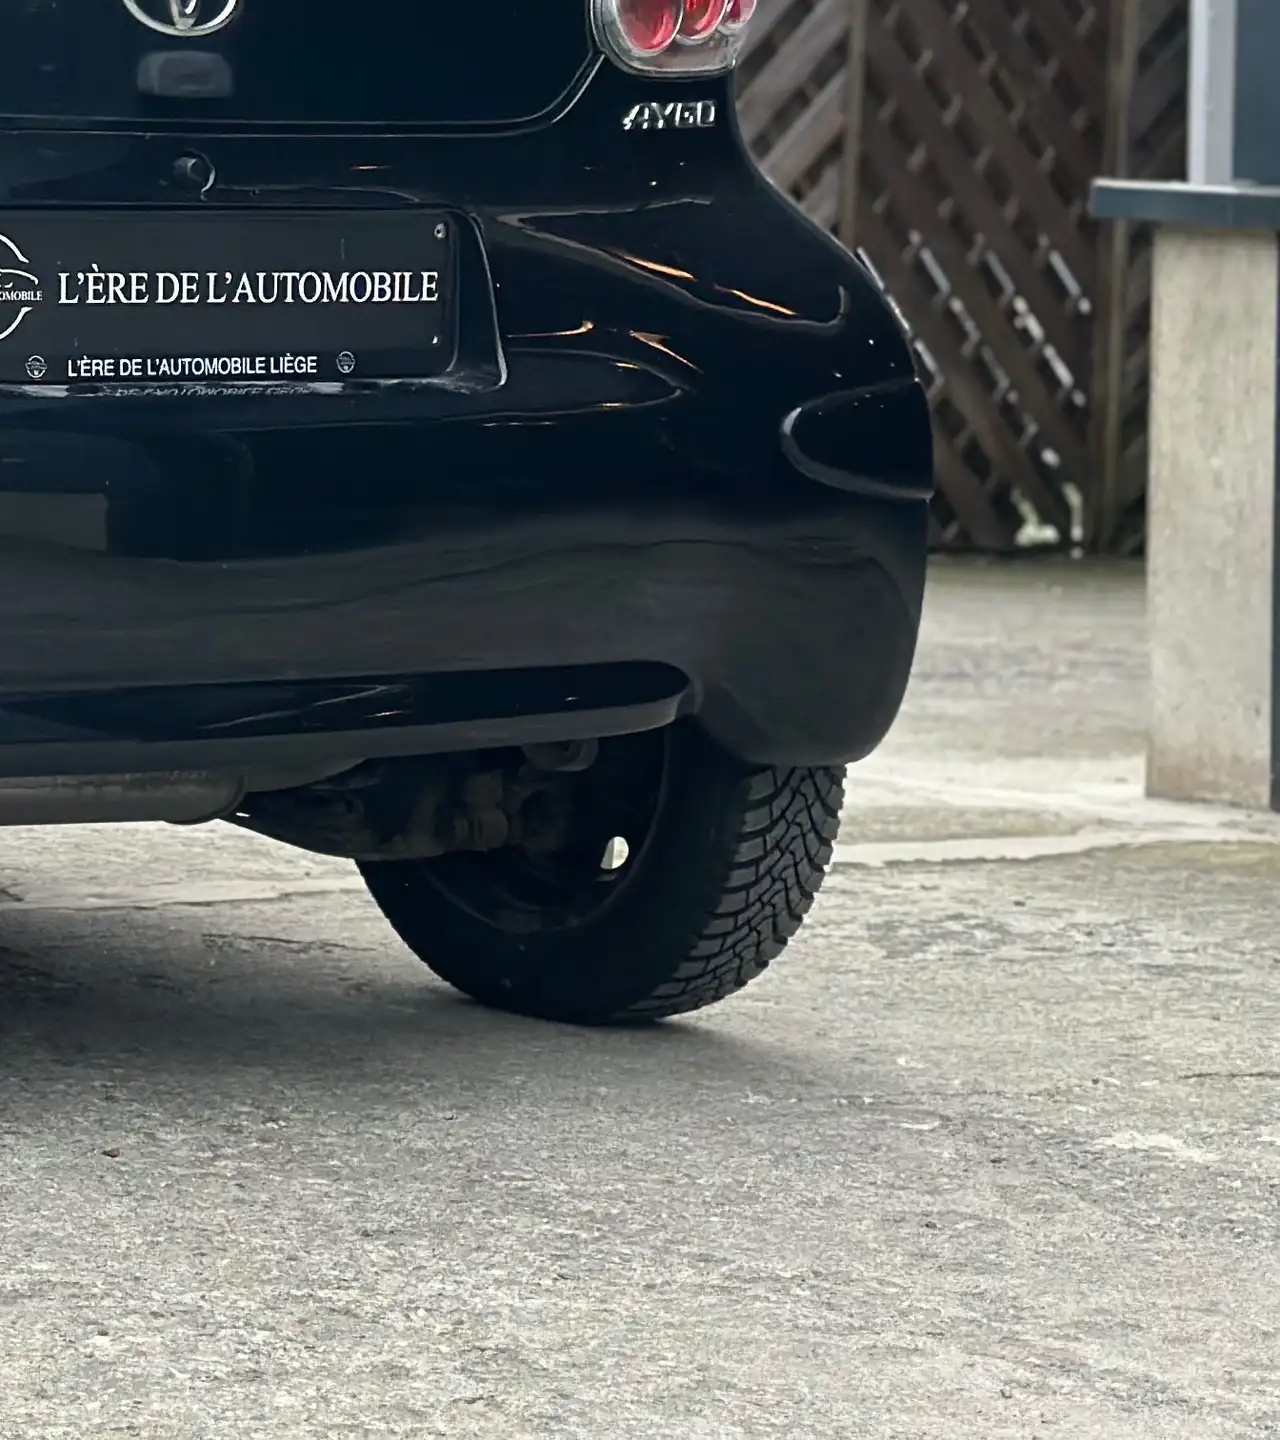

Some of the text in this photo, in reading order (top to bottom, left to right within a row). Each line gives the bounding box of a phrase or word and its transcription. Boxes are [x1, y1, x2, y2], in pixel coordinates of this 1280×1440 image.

[58, 263, 439, 304] L'ÈRE DE L'AUTOMOBILE
[67, 355, 115, 377] L'ÈRE
[119, 359, 142, 376] DE
[147, 357, 266, 376] L'AUTOMOBILE
[270, 353, 318, 374] LIÈGE
